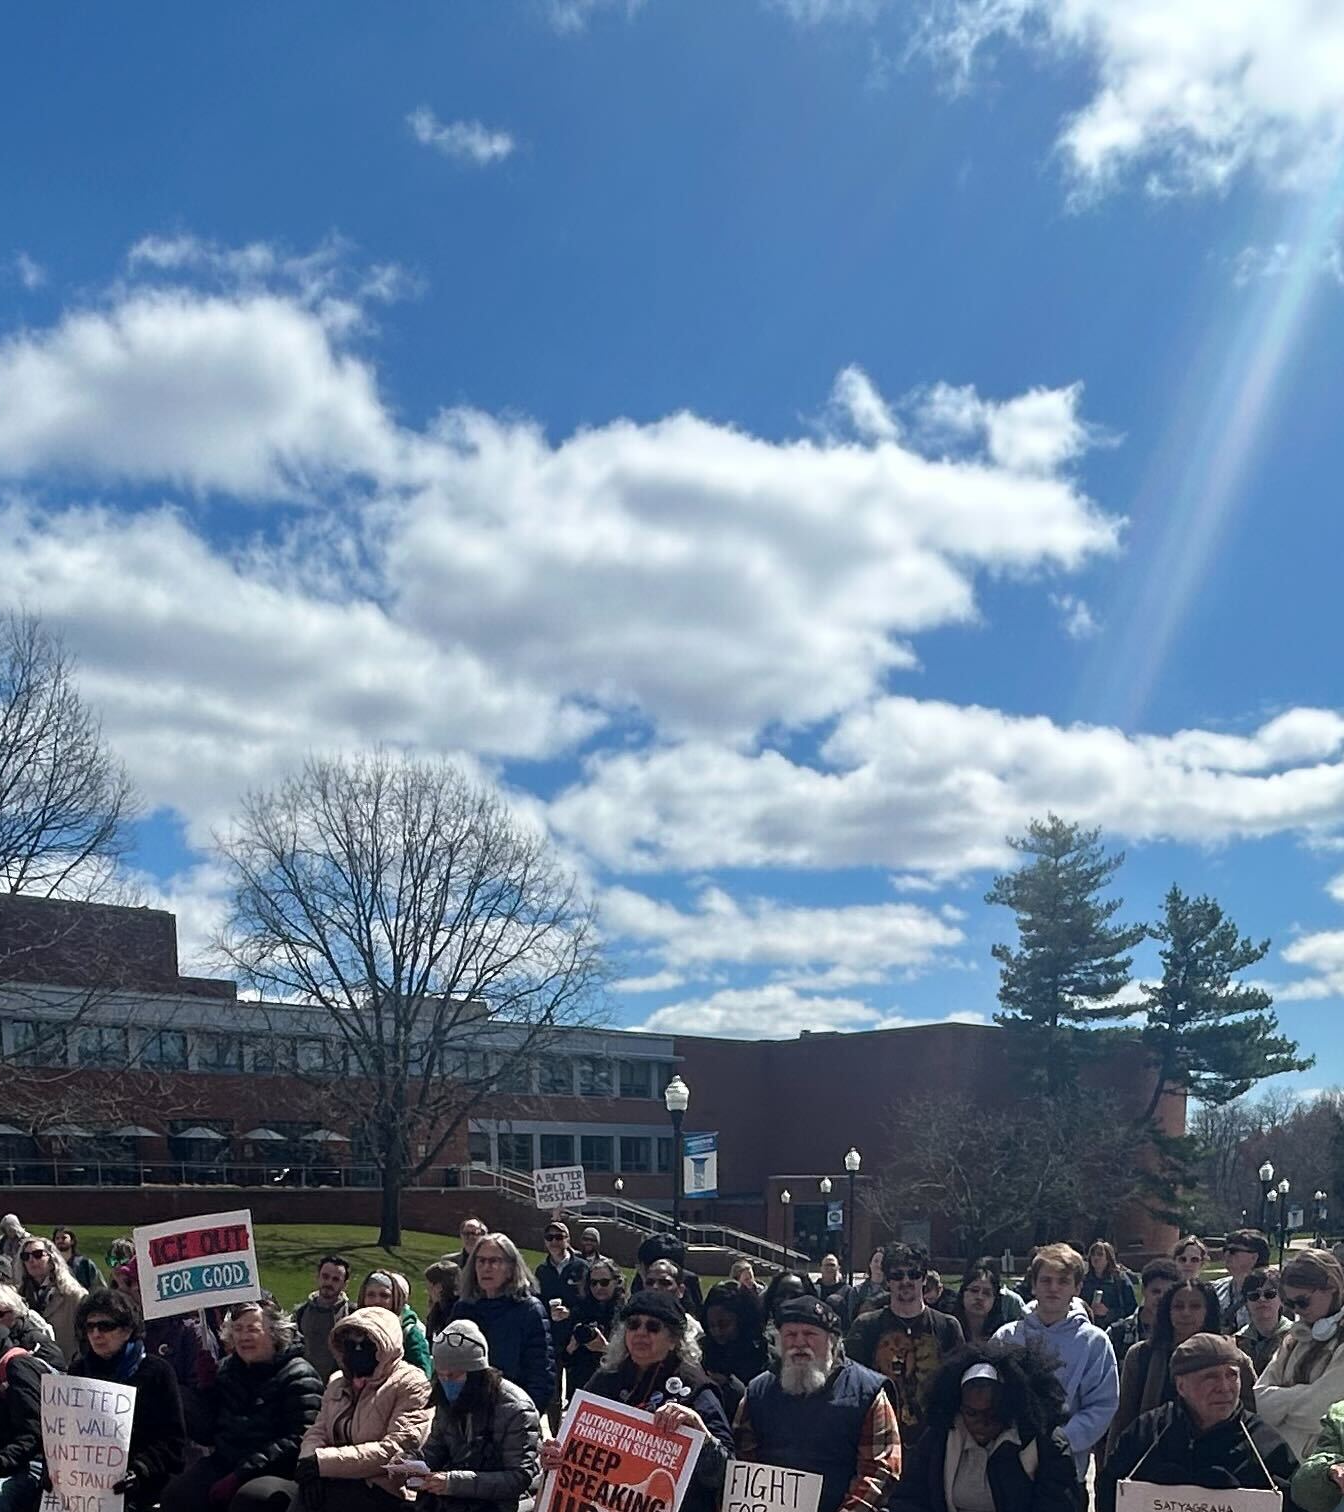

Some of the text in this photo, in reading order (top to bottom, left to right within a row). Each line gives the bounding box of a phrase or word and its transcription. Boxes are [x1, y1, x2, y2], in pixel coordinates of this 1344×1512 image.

[536, 1170, 582, 1183] A BETTER
[537, 1181, 581, 1193] WORLD IS
[538, 1190, 585, 1203] POSSIBLE
[161, 1264, 244, 1296] FOR GOOD
[42, 1384, 132, 1415] UNITED
[44, 1416, 127, 1440] WE WALK
[573, 1422, 620, 1449] THRIVES
[617, 1437, 631, 1453] IN
[579, 1411, 683, 1457] AUTHORITARIANISM
[46, 1444, 124, 1468] UNITED
[563, 1437, 622, 1476] KEEP
[730, 1464, 806, 1509] FIGHT
